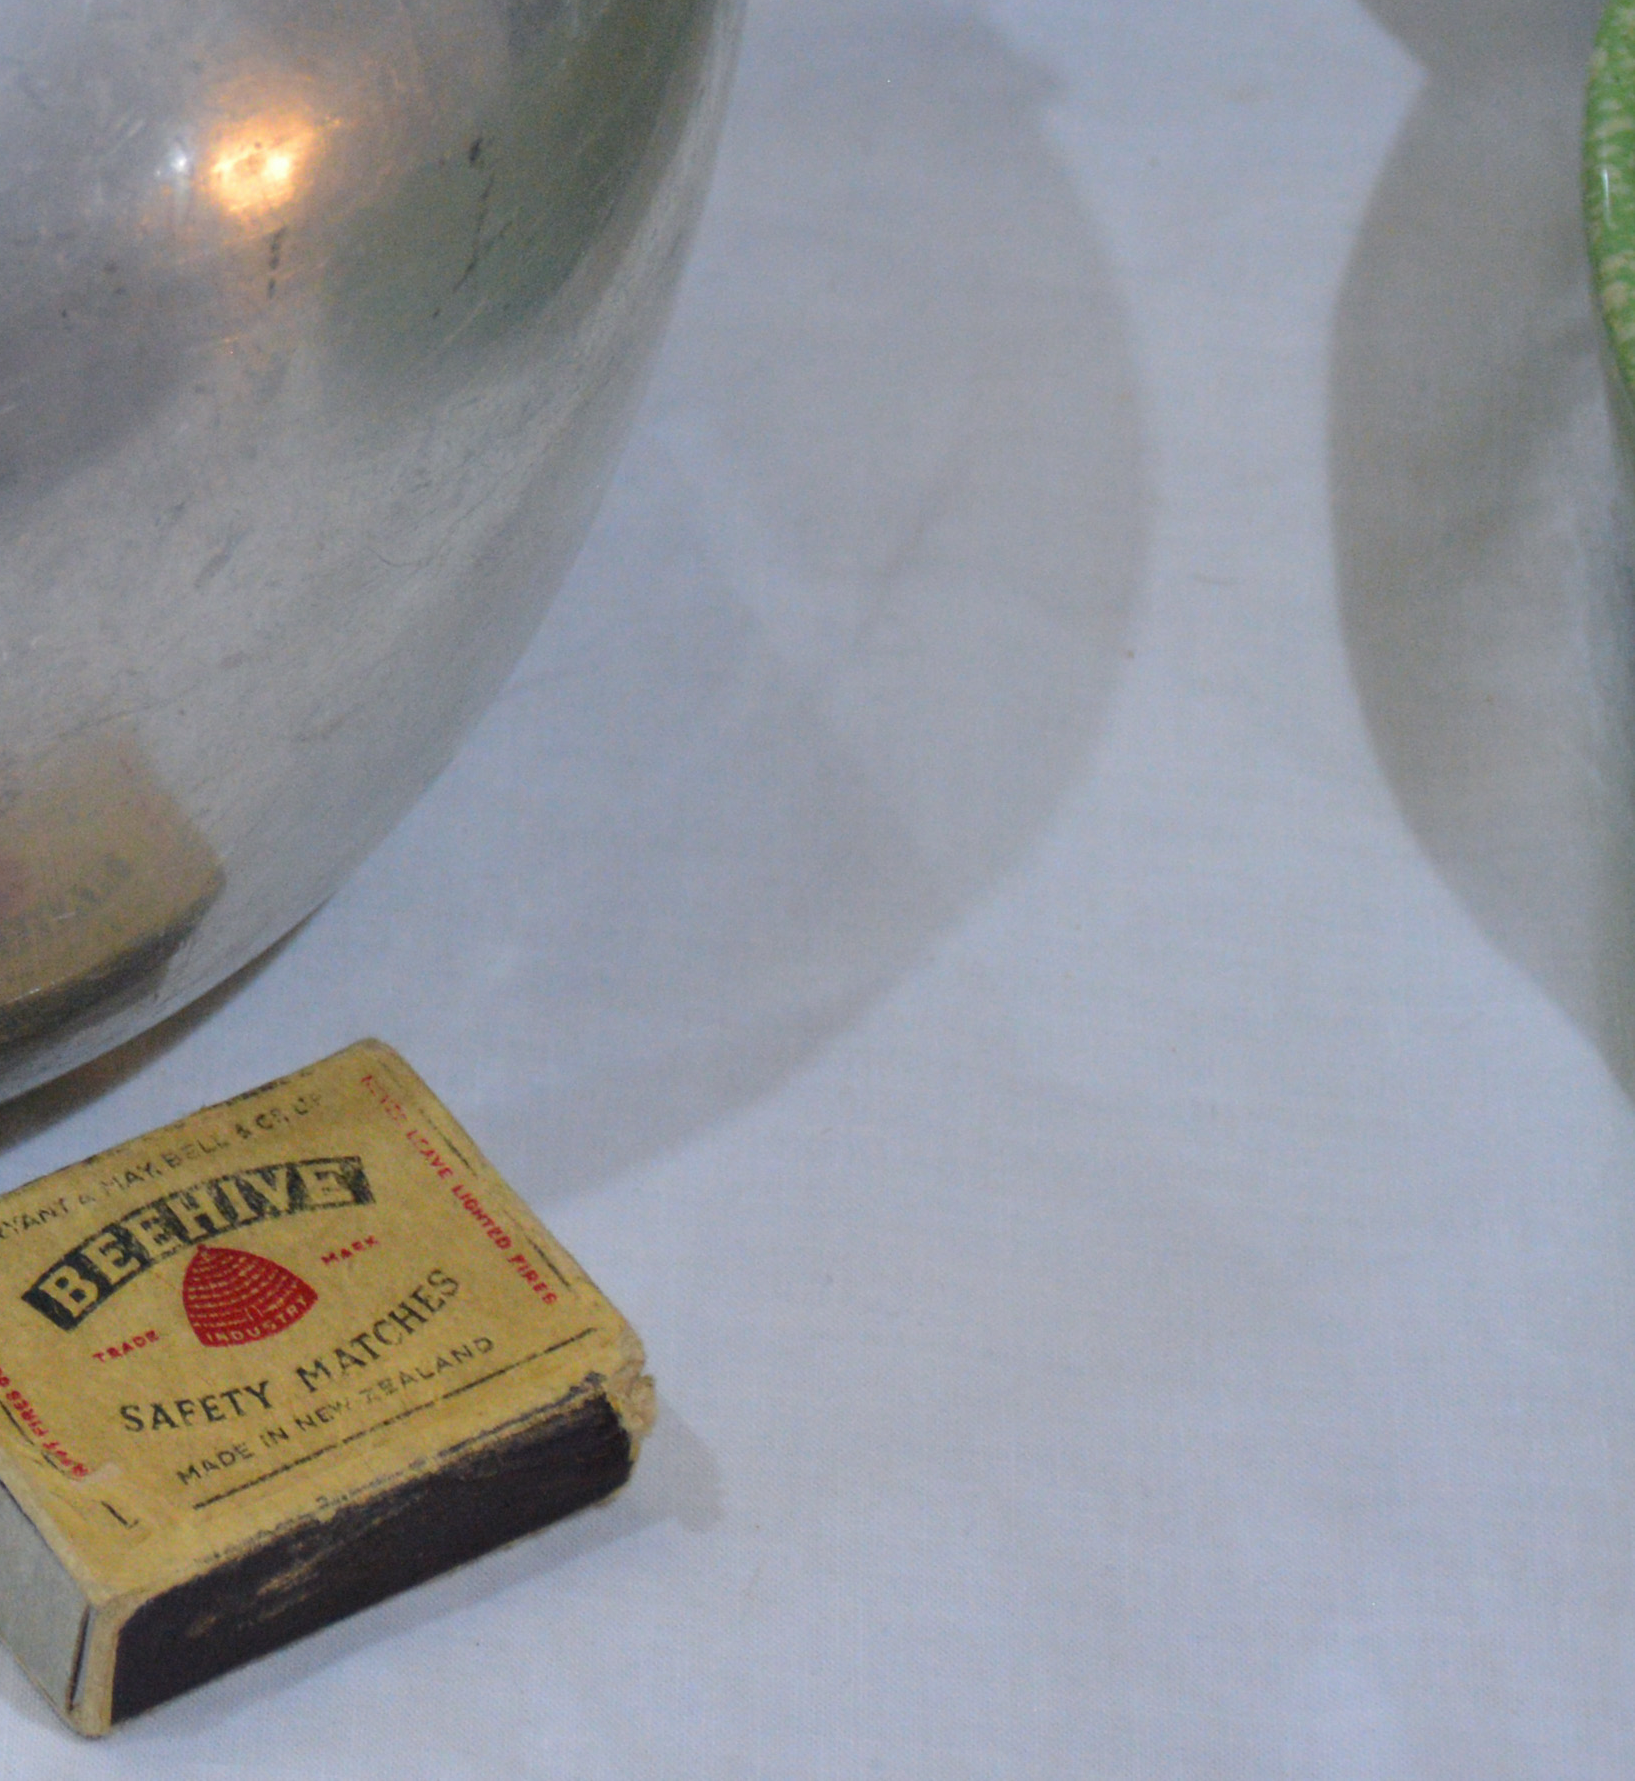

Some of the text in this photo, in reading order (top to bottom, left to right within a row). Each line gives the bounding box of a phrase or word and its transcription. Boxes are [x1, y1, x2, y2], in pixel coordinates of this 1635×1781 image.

[160, 1133, 231, 1169] BELL
[405, 1129, 455, 1180] LEAVE
[450, 1183, 513, 1250] LIGHTED
[507, 1253, 558, 1306] FIRES
[38, 1160, 354, 1318] BEEHIVE
[92, 1234, 380, 1364] TRADE MARK
[120, 1268, 461, 1433] SAFETY MATCHES
[206, 1298, 307, 1344] INDUSTRY
[176, 1335, 496, 1486] MADE IN NEW ZEALAND
